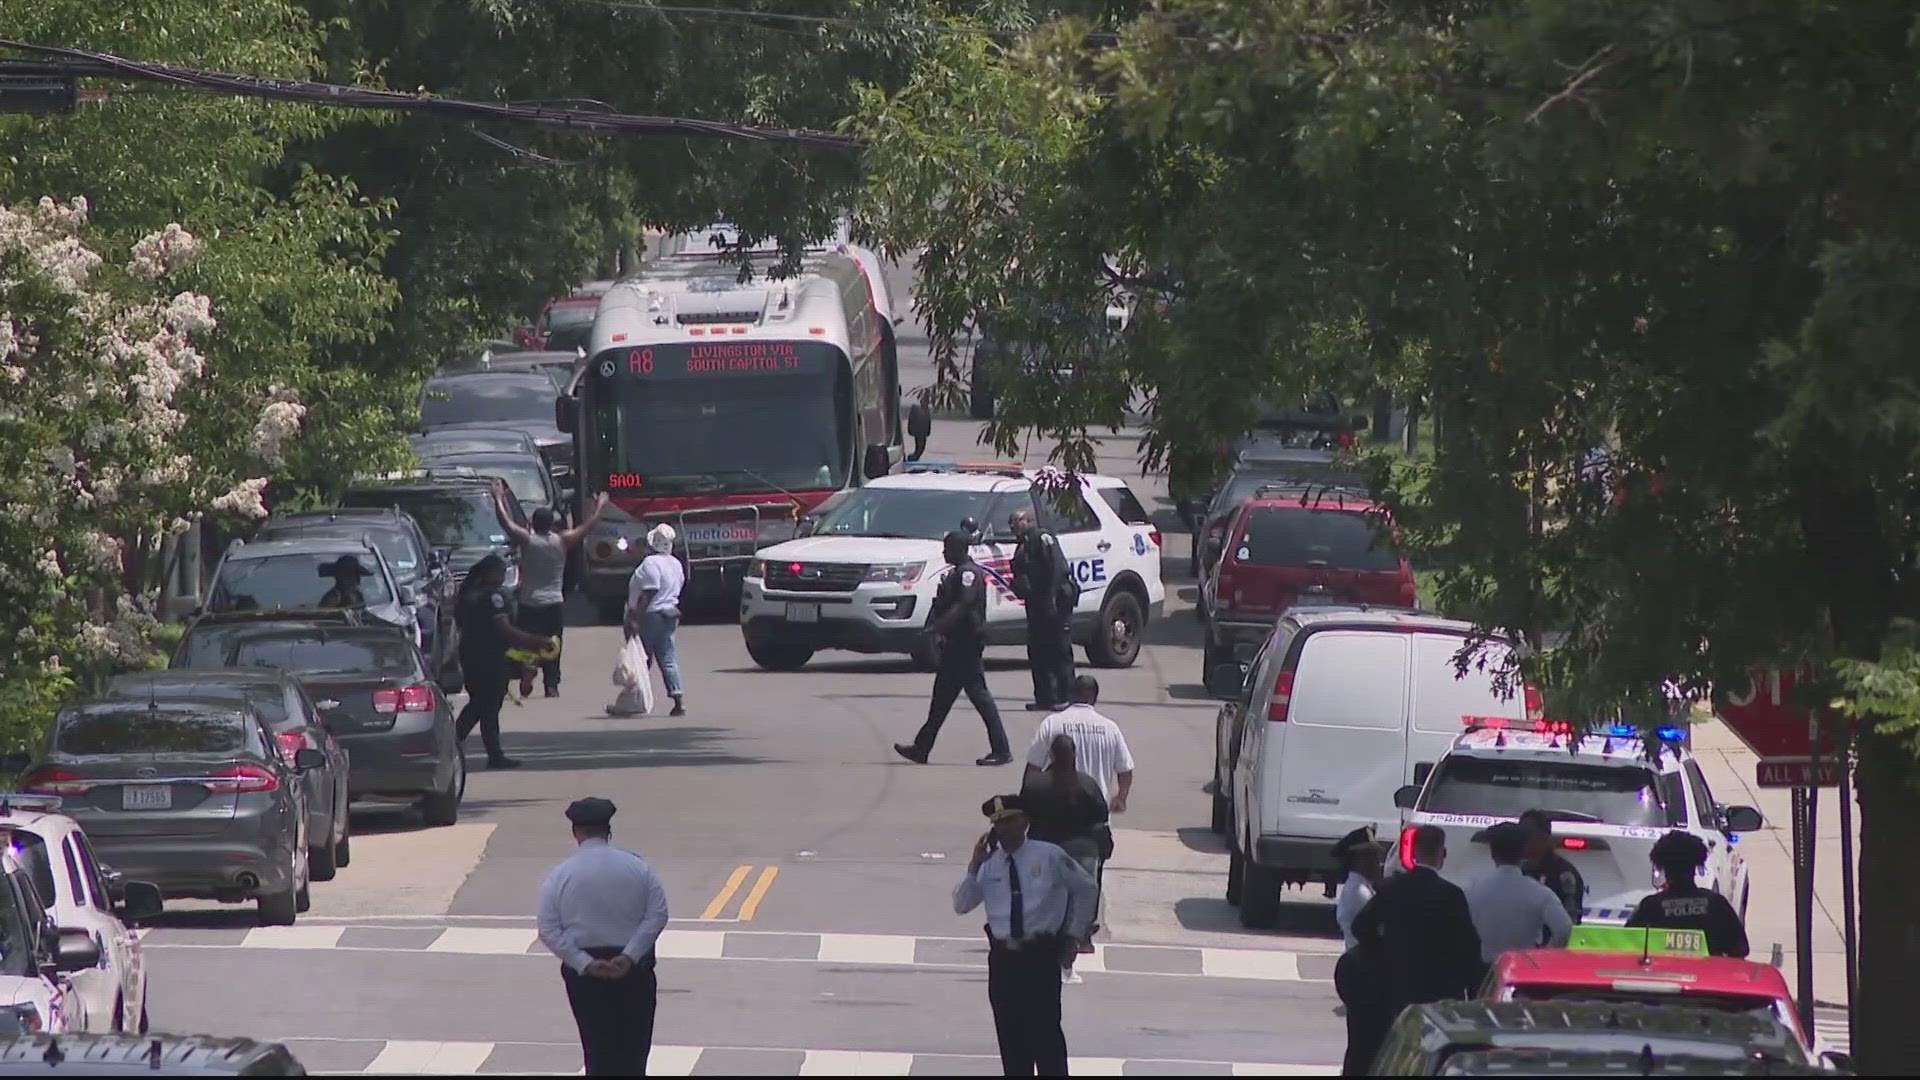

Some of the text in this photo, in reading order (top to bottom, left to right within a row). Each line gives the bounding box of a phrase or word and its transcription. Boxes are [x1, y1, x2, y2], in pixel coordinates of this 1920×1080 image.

[690, 344, 794, 358] LIVINGSTON VIA
[629, 349, 655, 374] A8
[686, 356, 800, 372] SOUTH CAPITOL ST
[608, 473, 642, 488] SA01
[688, 527, 758, 540] metrobus
[1069, 558, 1106, 583] ICE
[1763, 765, 1792, 782] ALL
[1664, 905, 1707, 917] POLICE
[1665, 932, 1701, 950] M098
